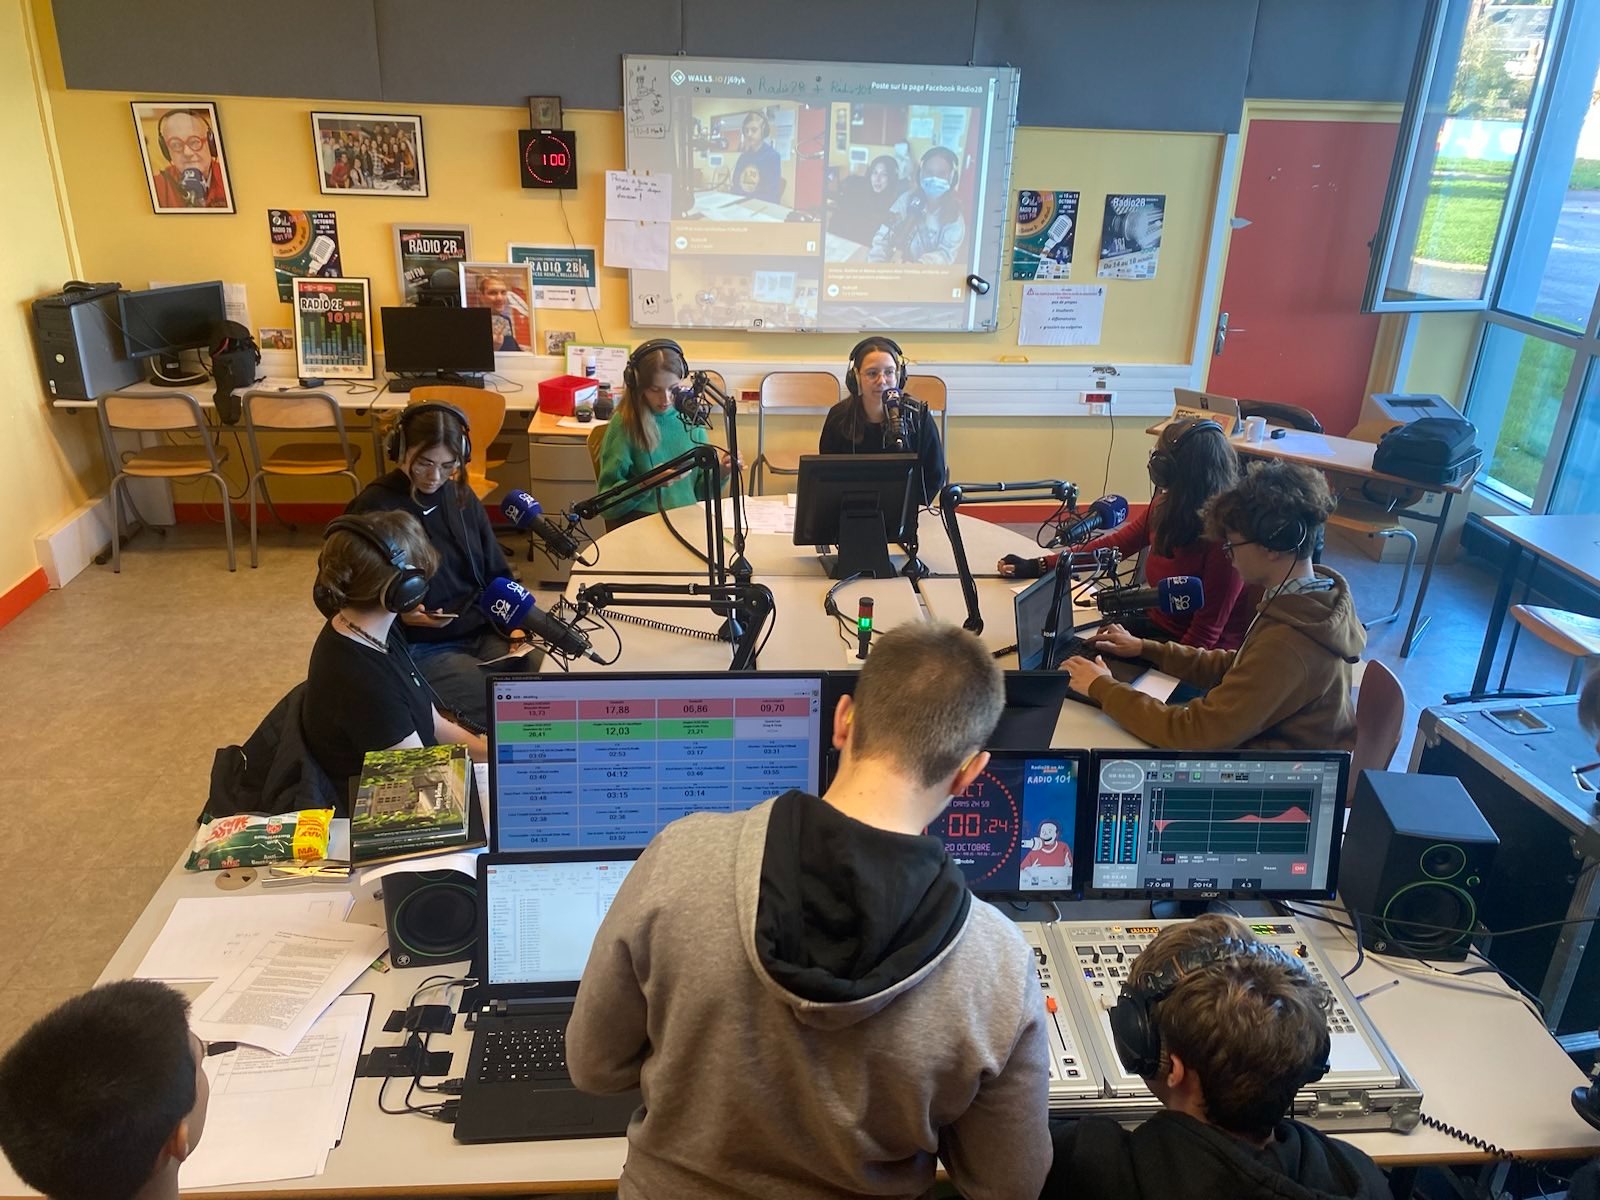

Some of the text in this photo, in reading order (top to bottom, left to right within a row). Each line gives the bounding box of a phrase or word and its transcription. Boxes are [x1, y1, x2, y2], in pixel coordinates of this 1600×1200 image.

[871, 81, 889, 89] Poste
[909, 84, 924, 93] page
[925, 84, 955, 93] Facebook
[409, 239, 458, 254] RADIO 2B
[530, 261, 579, 273] RADIO 2B
[301, 298, 329, 310] RADIO
[327, 311, 350, 324] 101
[605, 705, 630, 716] 17,88
[683, 704, 708, 714] 06,86
[760, 703, 785, 713] 09,70
[605, 727, 630, 737] 12,03
[606, 770, 628, 778] 04:12
[1027, 775, 1052, 785] RADIO
[606, 791, 628, 799] 03:15
[684, 789, 705, 797] 03:14
[944, 842, 991, 852] 20 OCTOBRE
